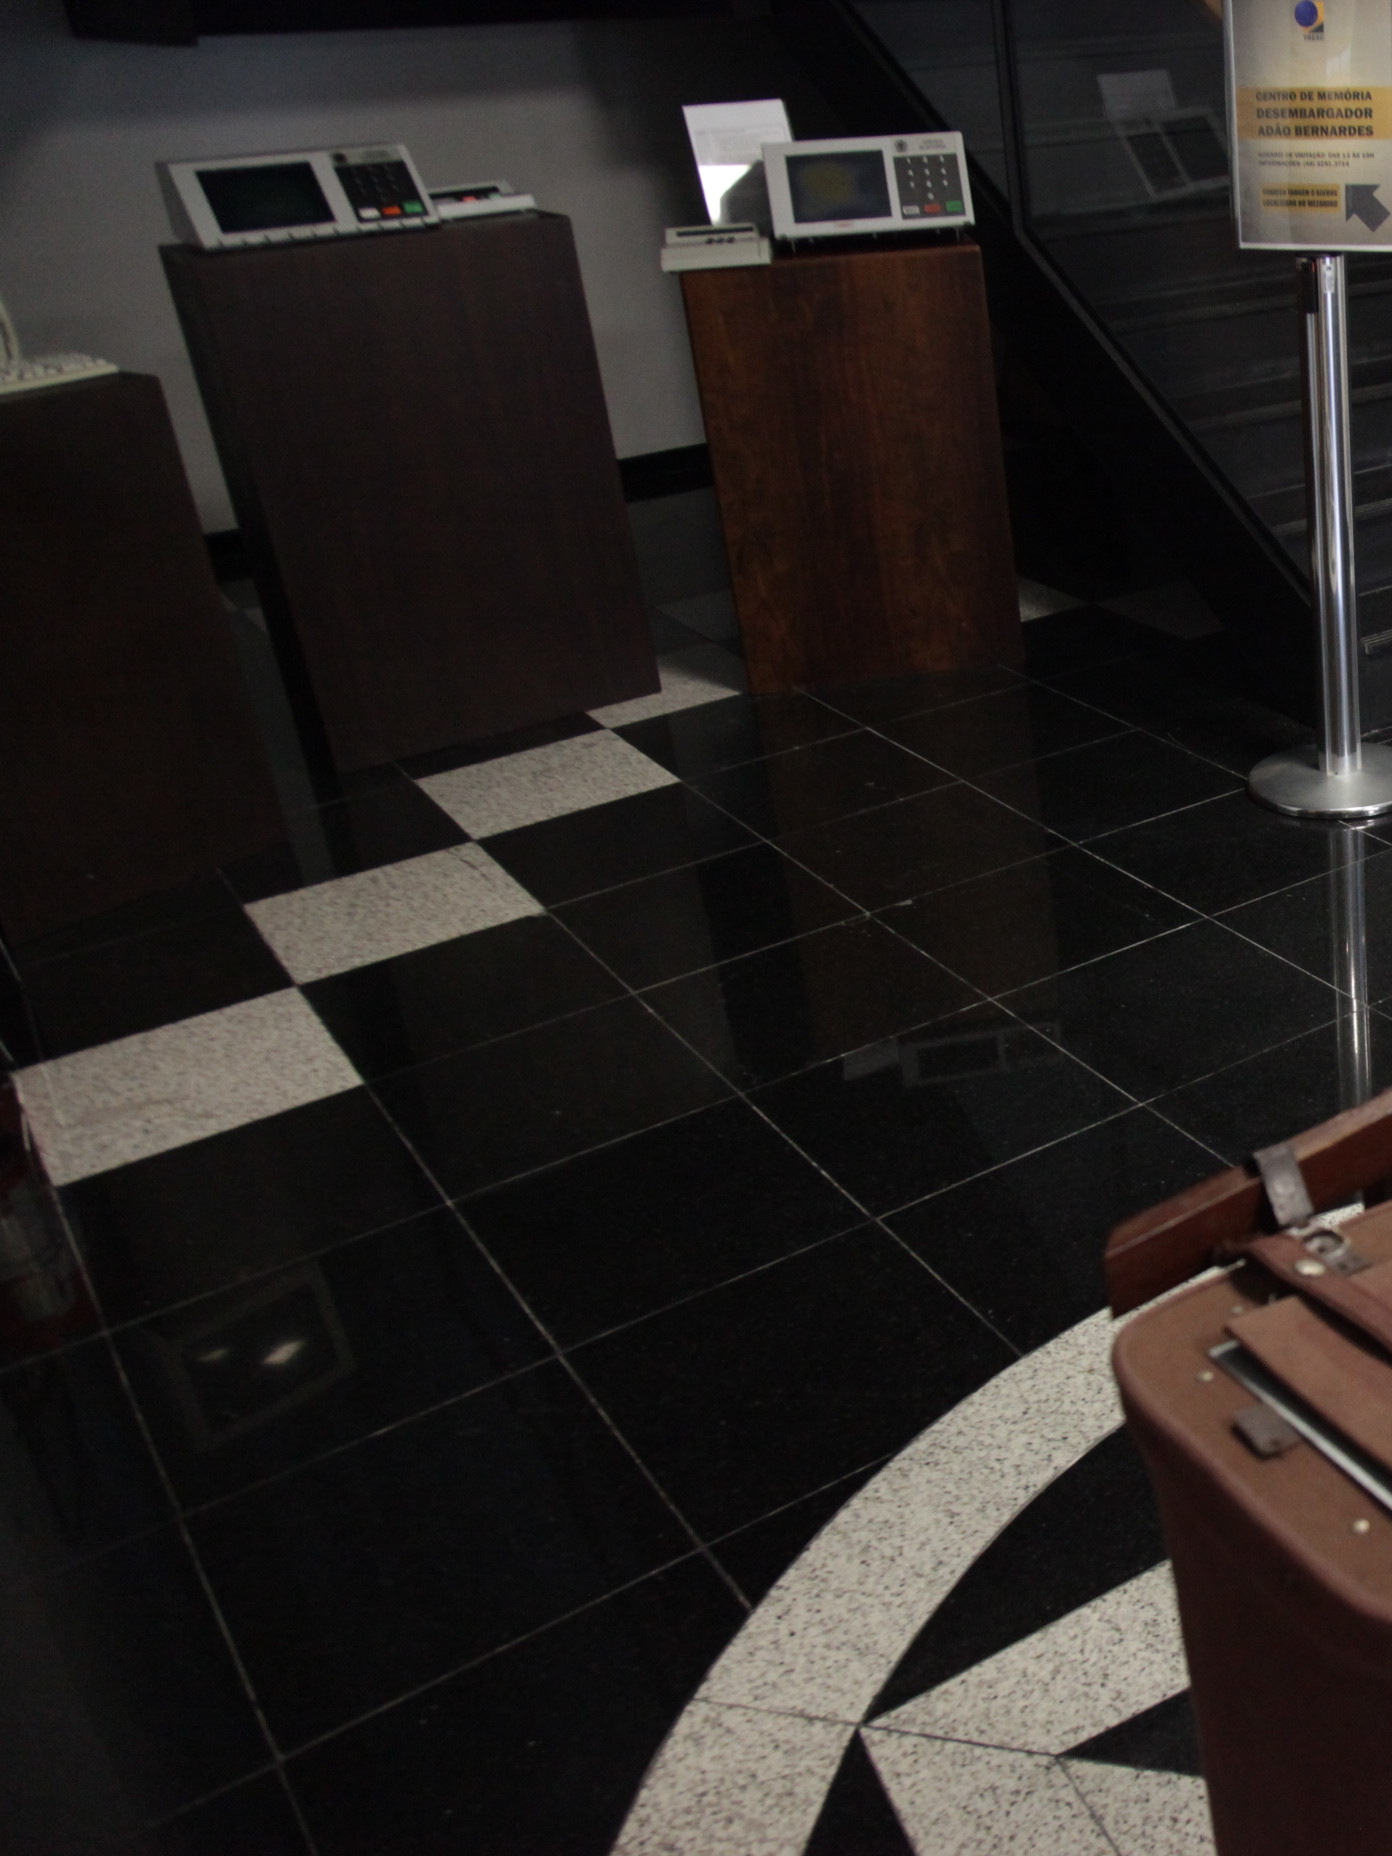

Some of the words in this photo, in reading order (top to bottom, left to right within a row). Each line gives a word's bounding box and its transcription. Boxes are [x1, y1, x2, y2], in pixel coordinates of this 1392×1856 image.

[1256, 91, 1296, 101] CENTRO
[1300, 91, 1314, 101] DE
[1317, 90, 1372, 100] MEMÓRIA
[1256, 107, 1373, 119] DESEMBARGADOR
[1258, 124, 1291, 136] ADÃO
[1294, 125, 1374, 137] BERNARDES
